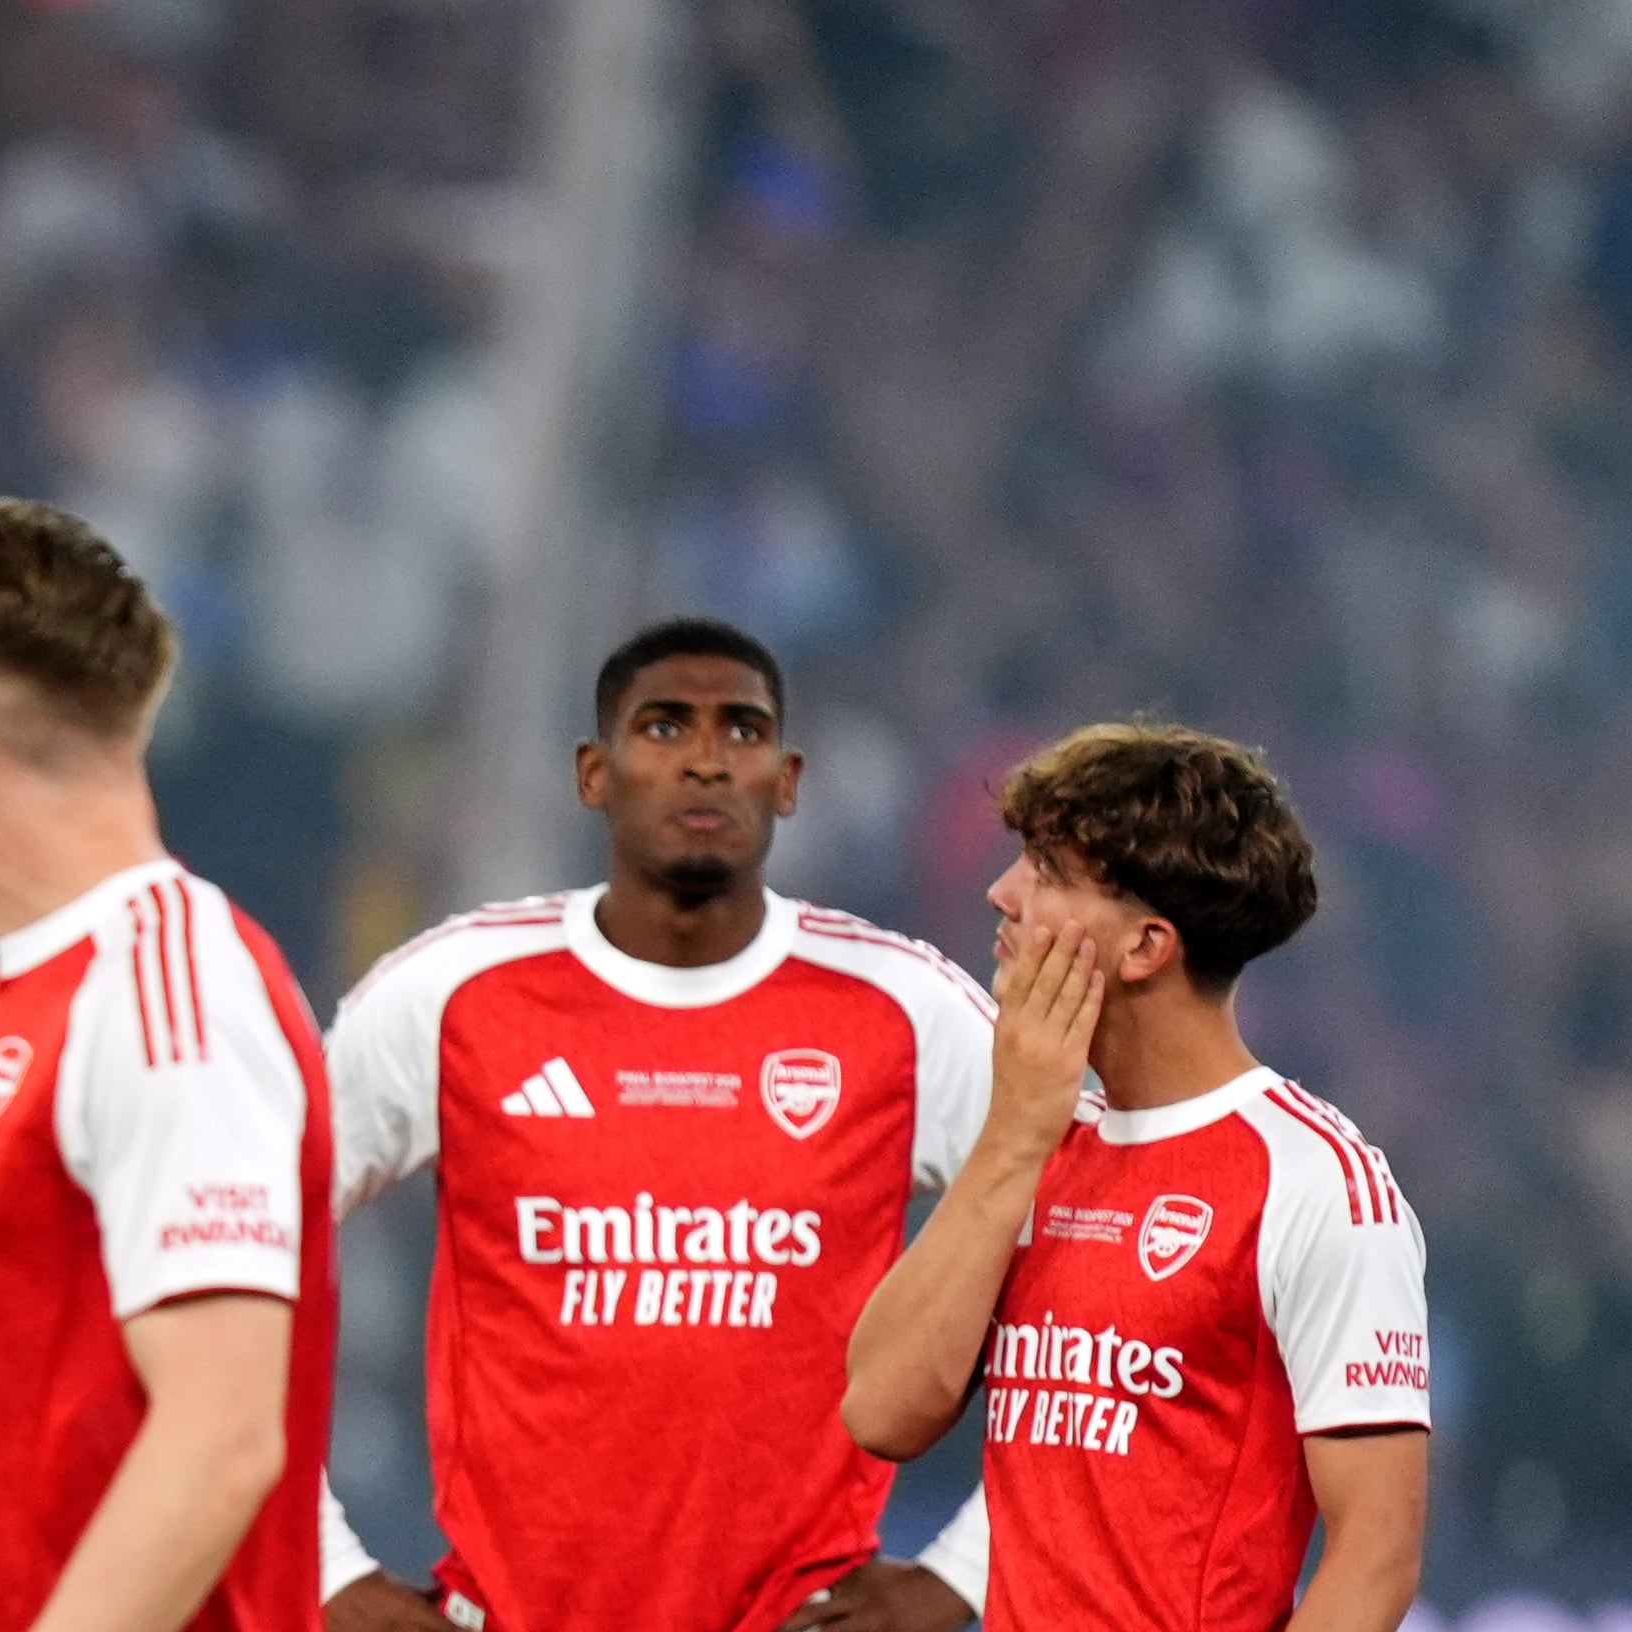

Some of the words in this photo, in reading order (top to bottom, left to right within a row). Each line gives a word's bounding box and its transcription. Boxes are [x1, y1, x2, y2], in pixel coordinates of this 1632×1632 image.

[515, 1191, 822, 1266] Emirates
[560, 1269, 627, 1327] FLY
[634, 1269, 778, 1328] BETTER
[984, 1310, 1184, 1399] mirates
[1375, 1329, 1424, 1359] VISIT
[1345, 1361, 1432, 1391] RWAND
